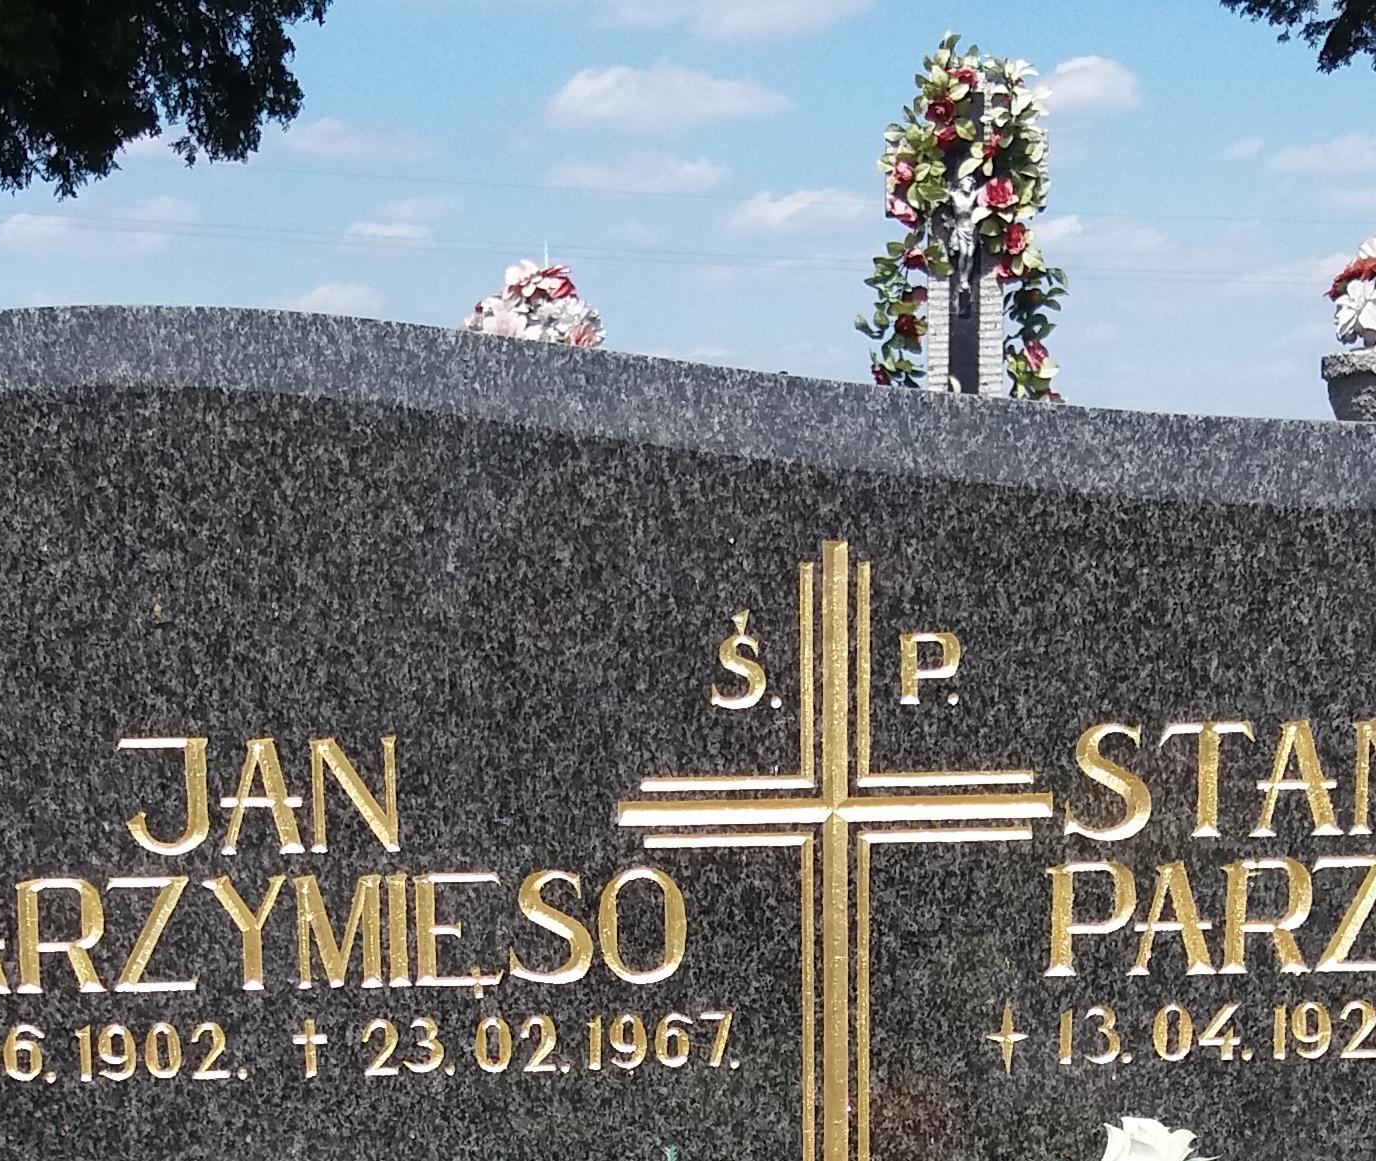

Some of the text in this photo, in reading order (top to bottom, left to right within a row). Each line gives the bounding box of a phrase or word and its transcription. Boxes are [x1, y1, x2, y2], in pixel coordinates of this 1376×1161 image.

[711, 608, 959, 710] Ś. P.
[117, 735, 402, 857] JAN
